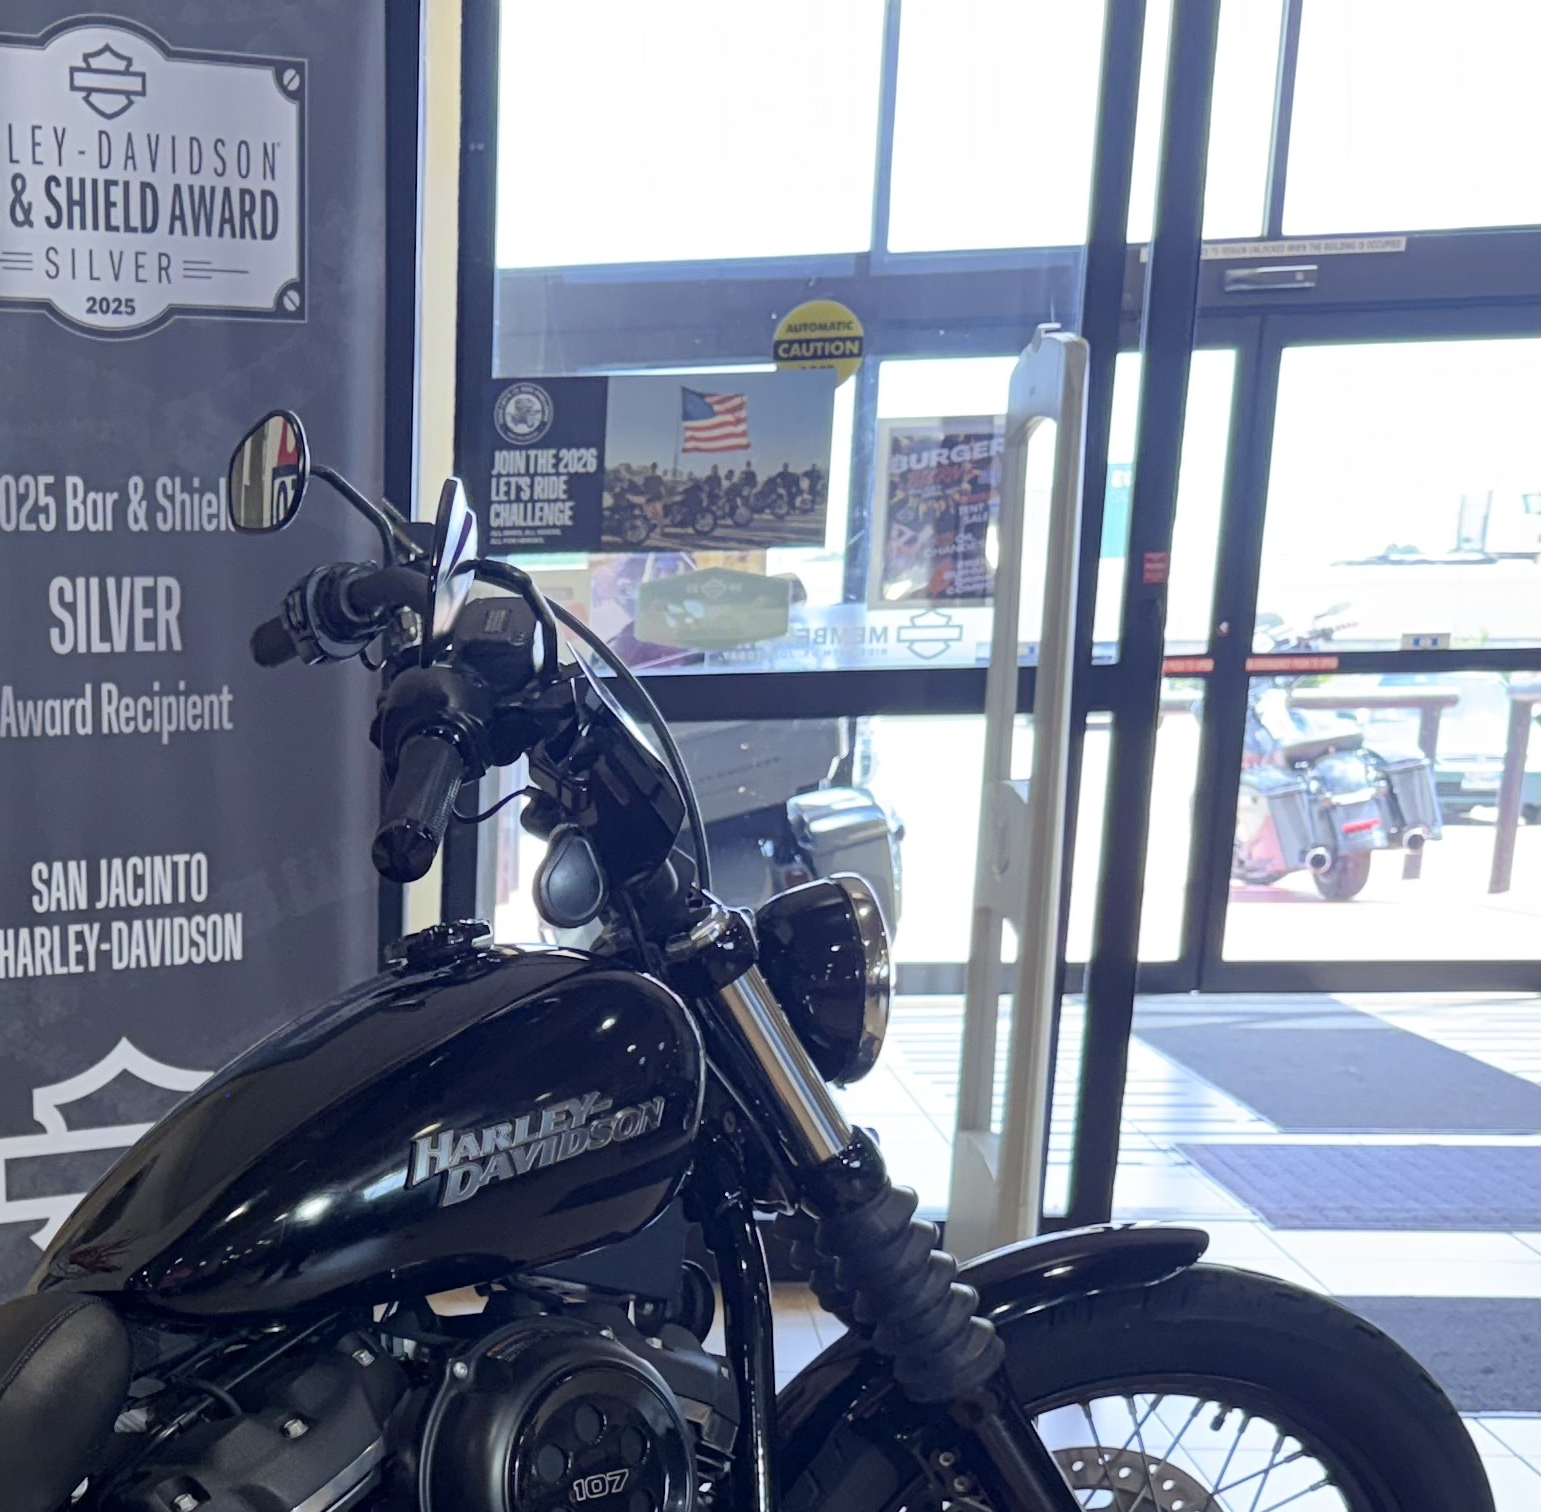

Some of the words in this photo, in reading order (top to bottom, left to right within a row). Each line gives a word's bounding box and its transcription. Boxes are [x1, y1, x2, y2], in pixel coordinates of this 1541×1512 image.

[9, 172, 34, 229] &
[44, 174, 159, 235] SHIELD
[168, 183, 279, 241] AWARD
[44, 246, 173, 285] SILVER
[85, 296, 137, 317] 2025
[786, 320, 855, 333] AUTOMATIC
[778, 340, 860, 359] CAUTION
[491, 449, 526, 475] JOIN
[527, 448, 558, 475] THE
[559, 447, 598, 474] 2026
[65, 476, 119, 532] Bar
[127, 475, 149, 532] &
[155, 476, 236, 532] Shiel
[490, 476, 532, 501] LET'S
[533, 475, 569, 500] RIDE
[489, 501, 575, 528] CHALLENGE
[48, 575, 183, 655] SILVER
[101, 680, 234, 745] Recipient
[31, 860, 88, 914] SAN
[95, 852, 209, 909] JACINTO
[439, 1096, 666, 1208] DAVIDSON
[573, 1467, 630, 1502] 107
